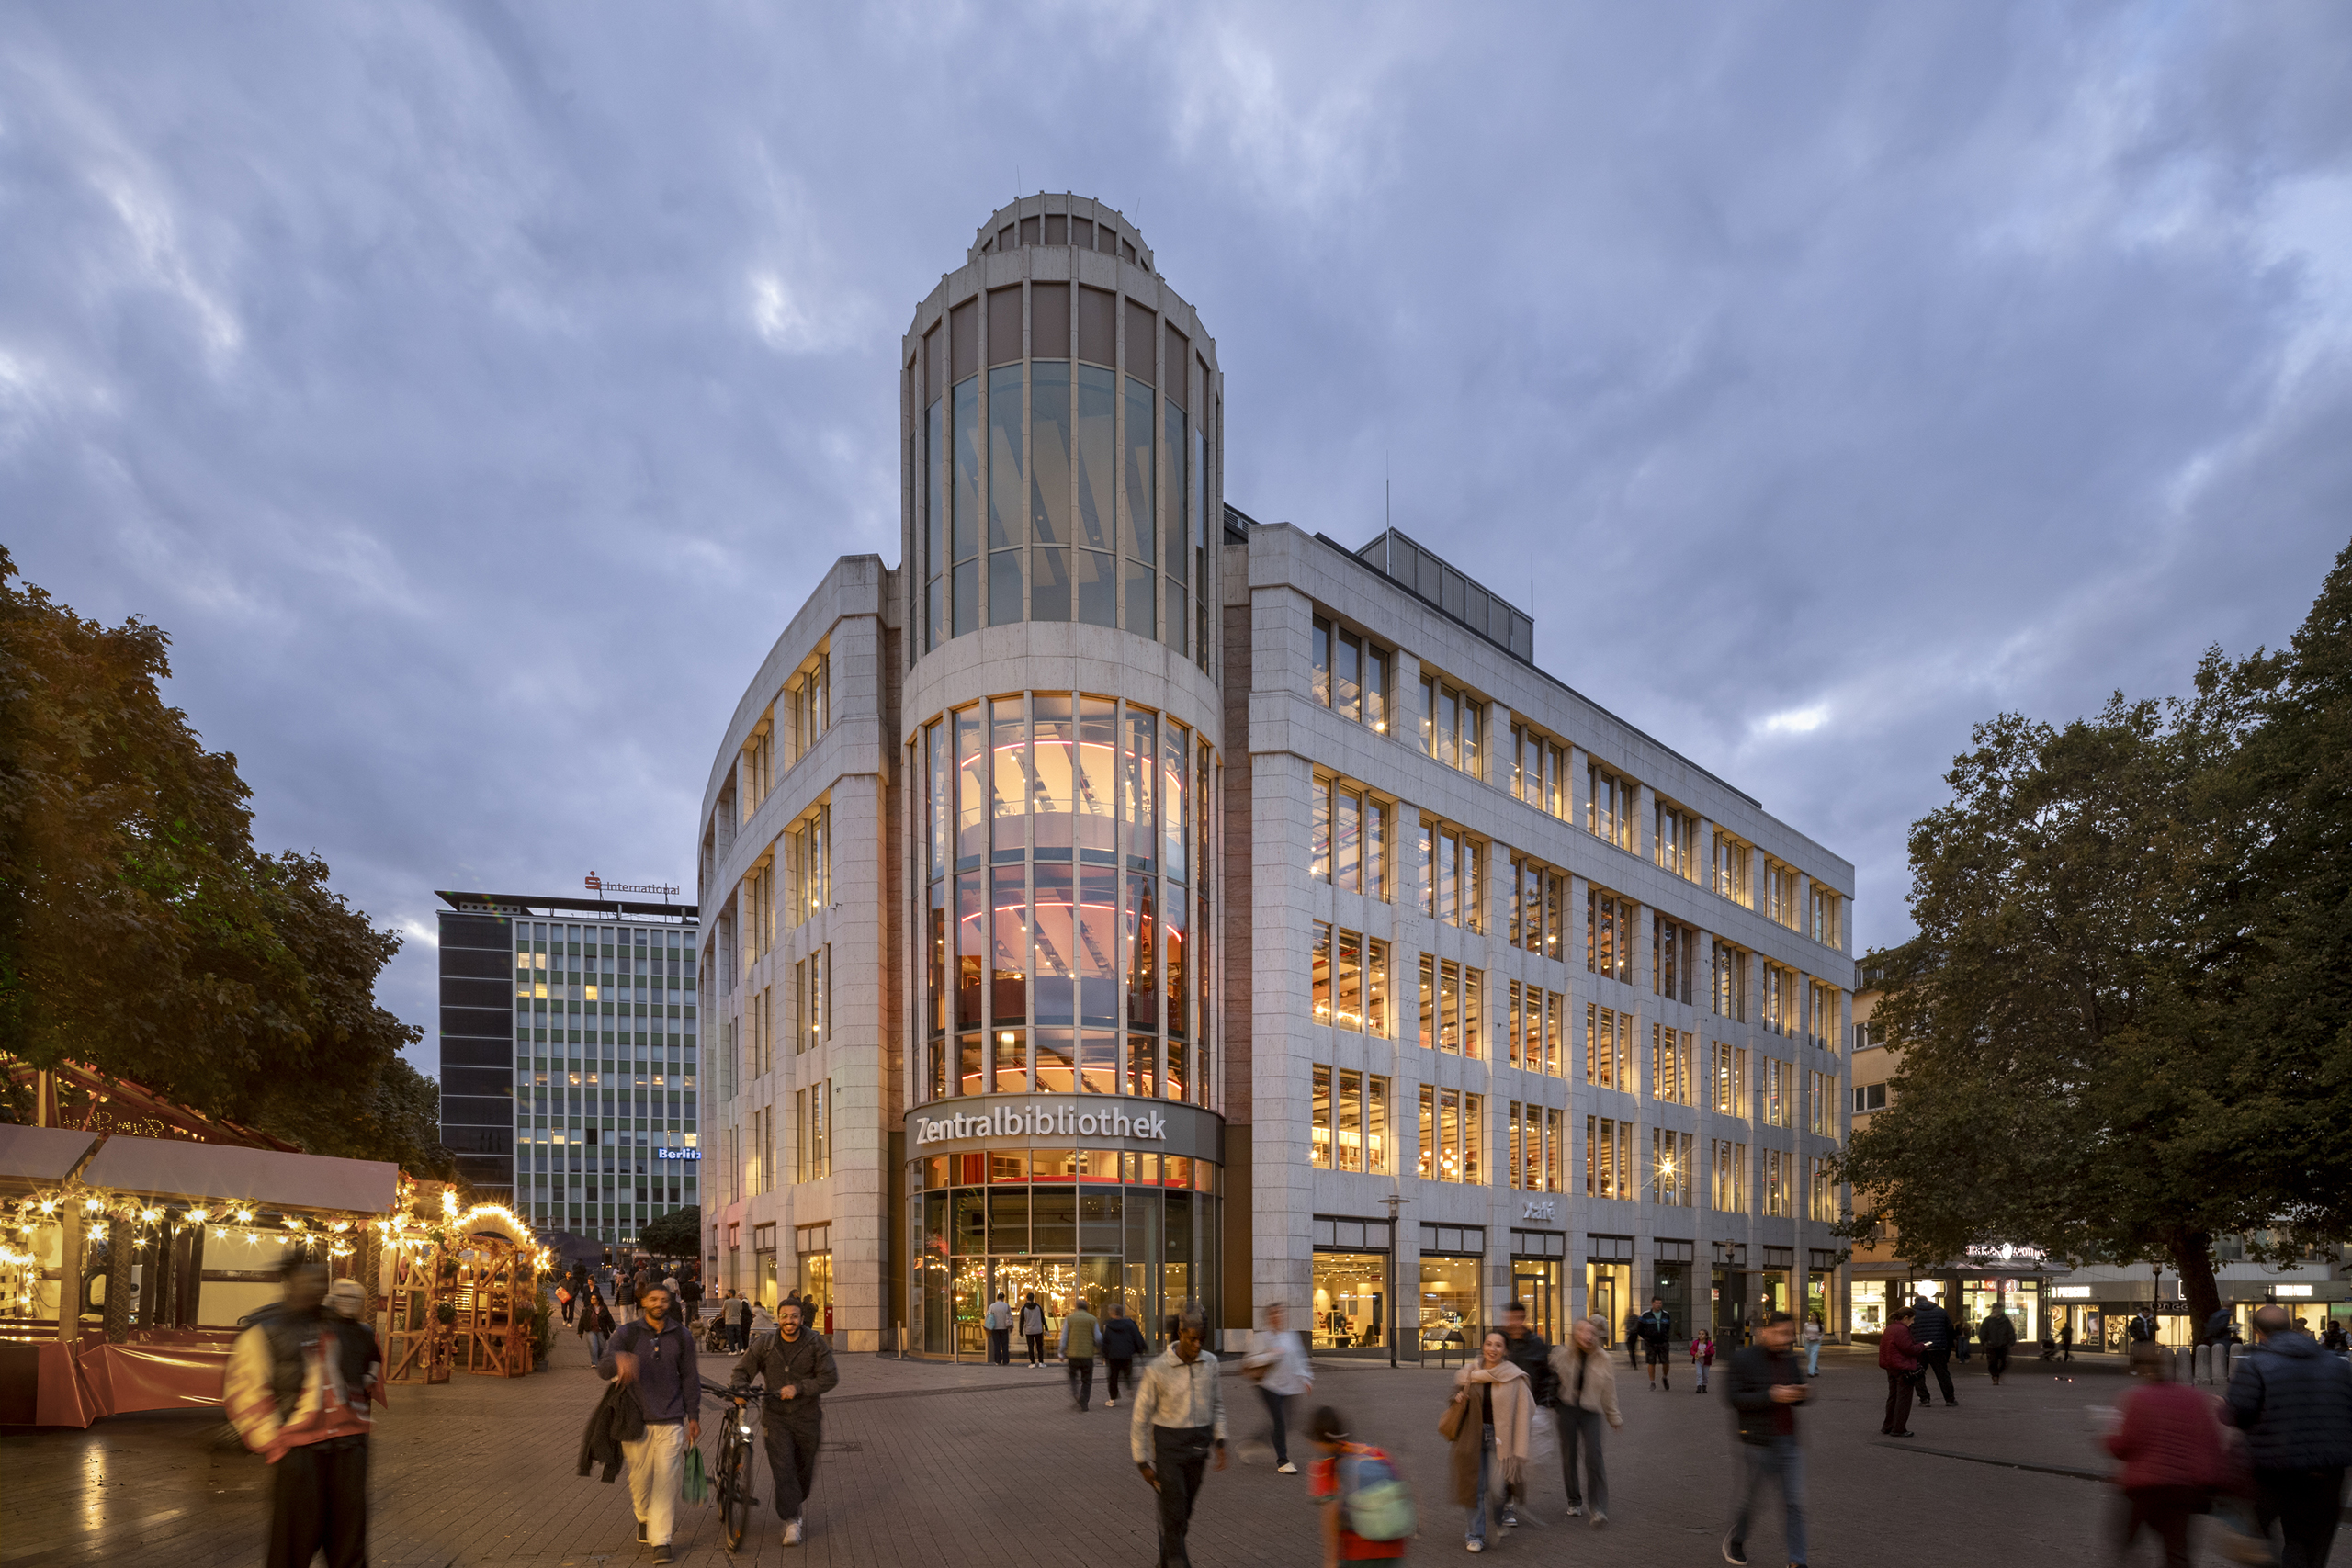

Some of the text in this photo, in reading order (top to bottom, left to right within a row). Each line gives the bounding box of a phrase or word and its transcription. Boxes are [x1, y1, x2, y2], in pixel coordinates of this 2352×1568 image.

[607, 882, 680, 895] International
[916, 1105, 1166, 1145] Zentralbibliothek
[659, 1148, 702, 1159] Berlitz
[1523, 1201, 1555, 1221] Xafé
